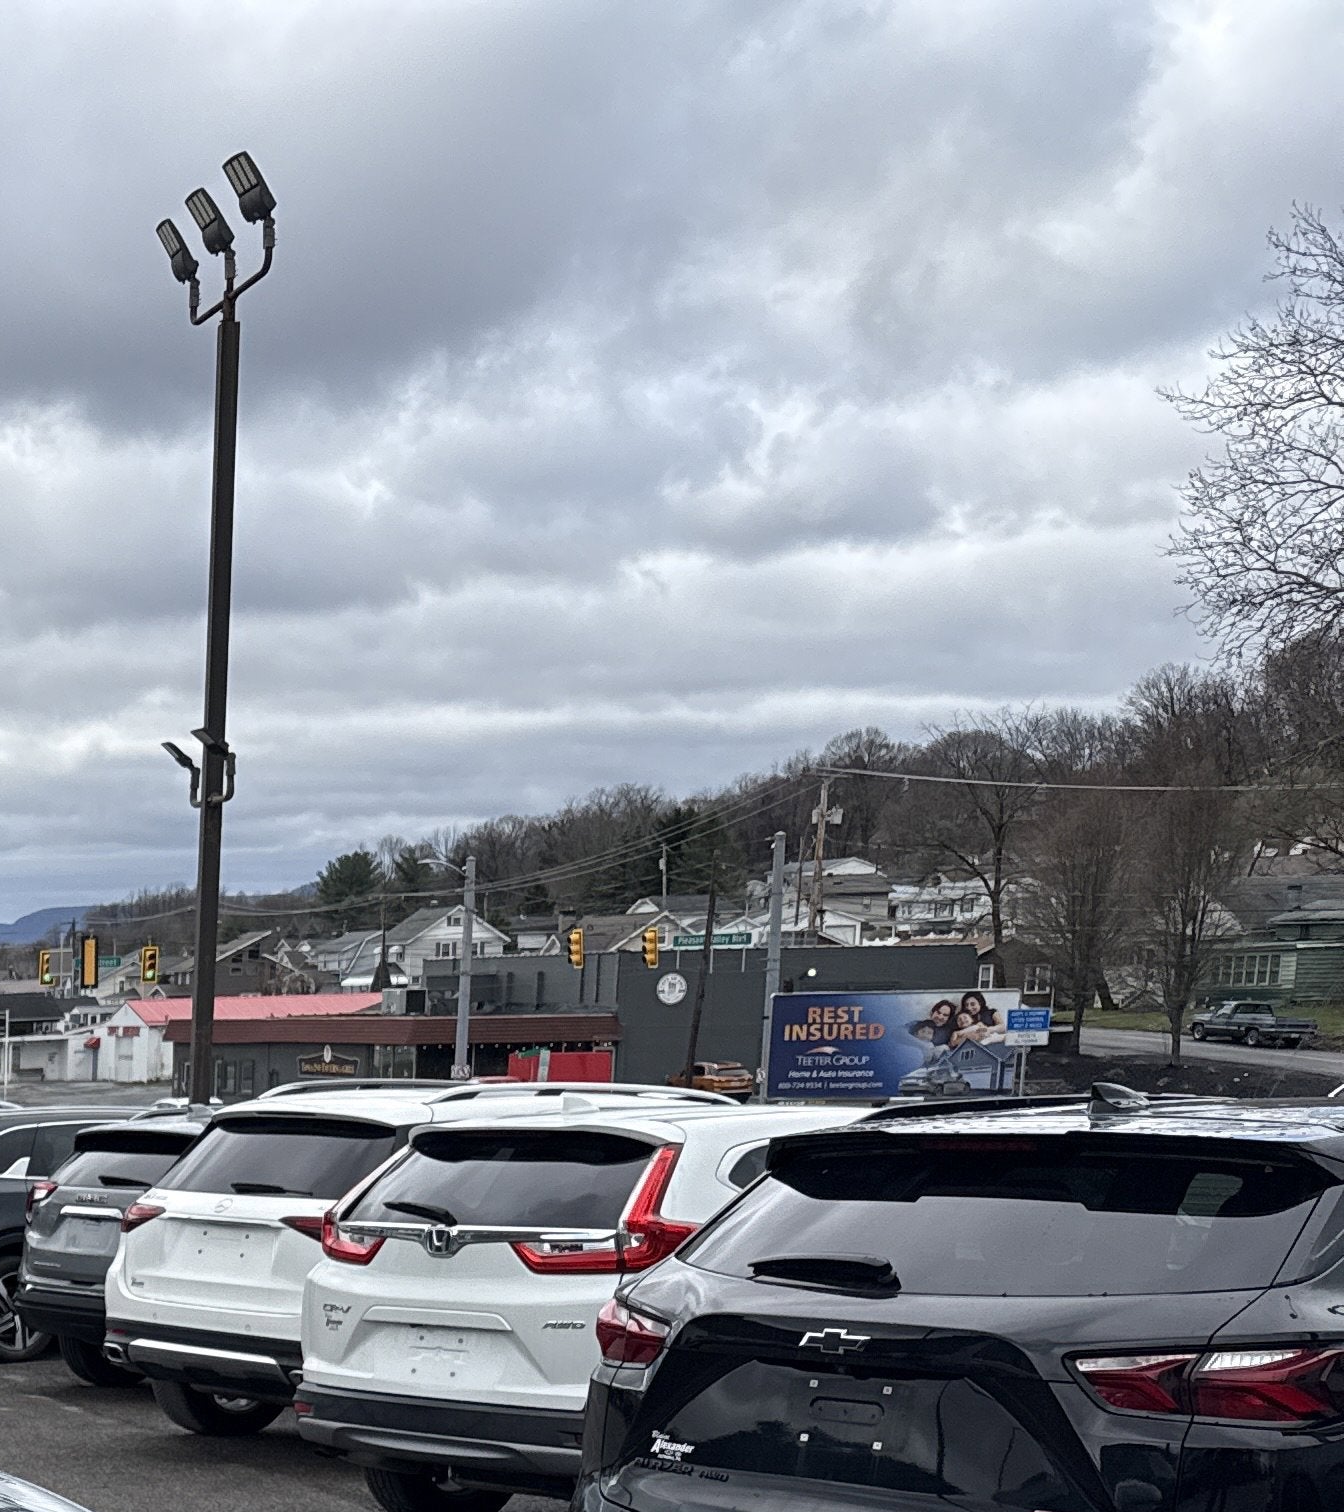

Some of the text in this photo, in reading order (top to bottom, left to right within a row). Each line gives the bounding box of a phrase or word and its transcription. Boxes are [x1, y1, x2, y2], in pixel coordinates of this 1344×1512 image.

[807, 1006, 864, 1024] REST
[783, 1023, 886, 1041] INSURED
[796, 1054, 870, 1067] TEETER GROUP
[837, 1069, 874, 1078] Insurance
[650, 1438, 695, 1454] Alexander
